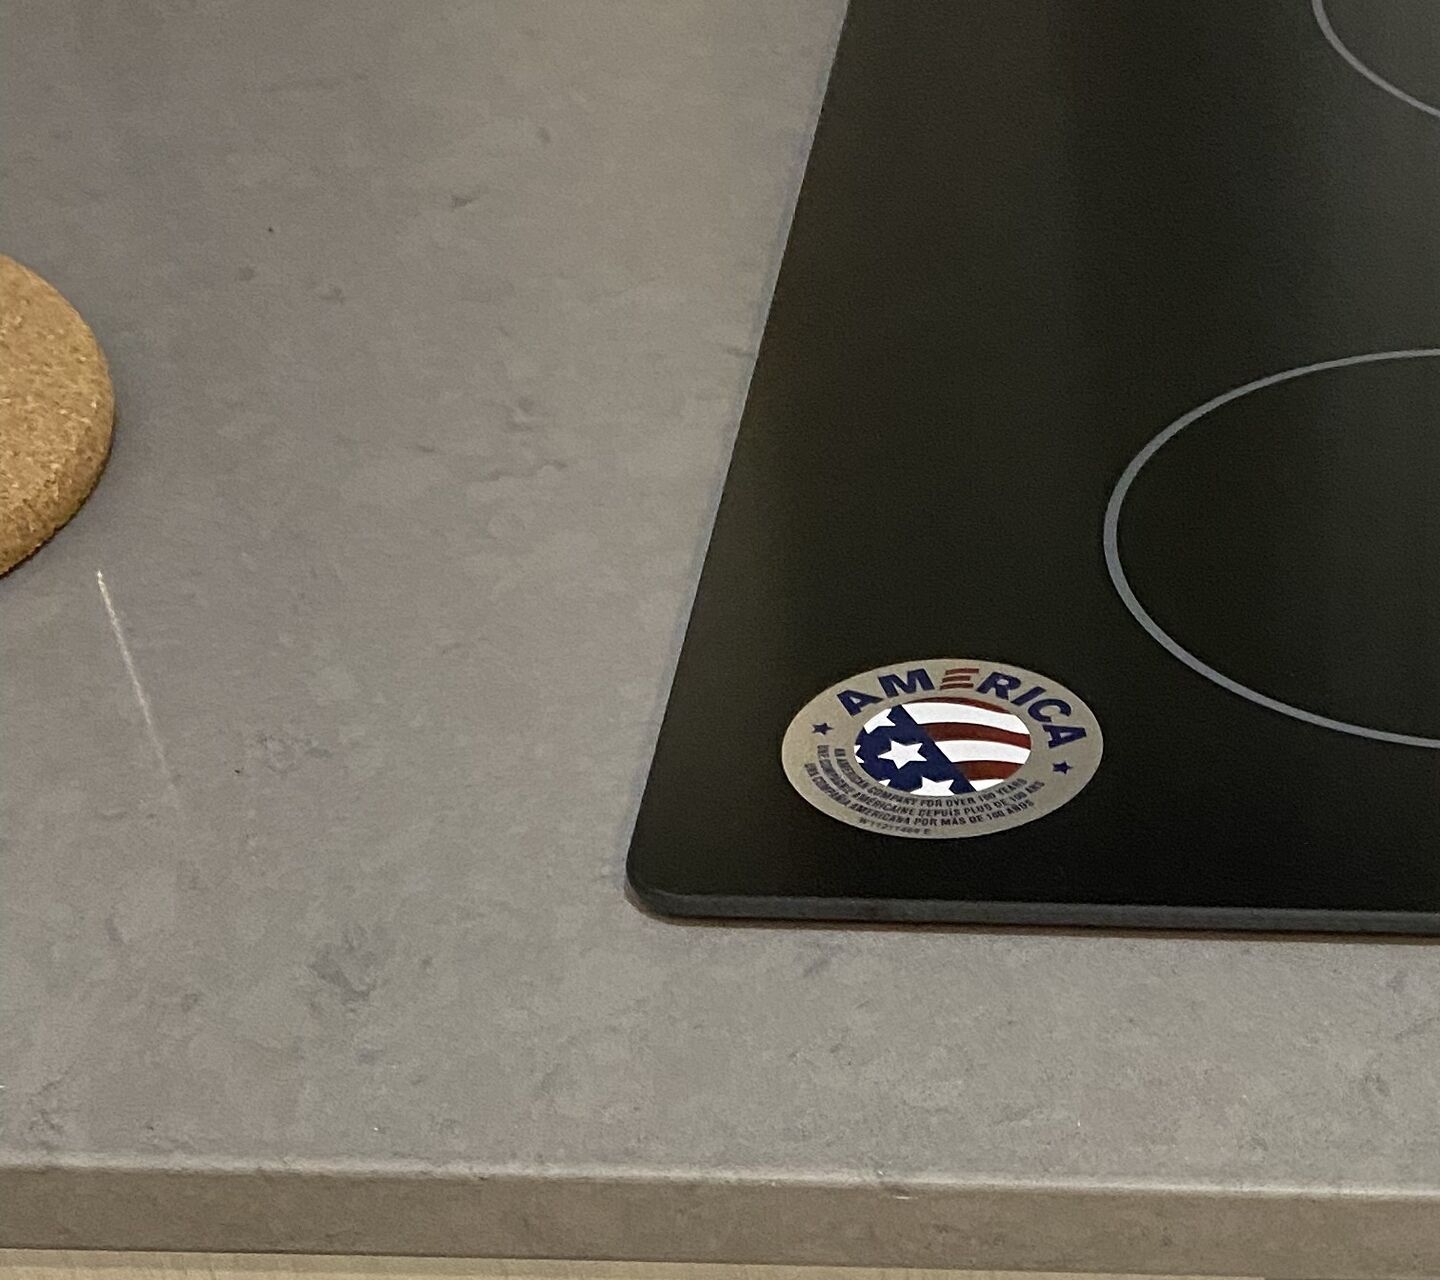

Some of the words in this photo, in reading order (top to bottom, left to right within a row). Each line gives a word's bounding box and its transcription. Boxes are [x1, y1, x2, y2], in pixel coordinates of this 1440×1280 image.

[836, 666, 1088, 749] AMERICA
[866, 786, 919, 806] COMPANY
[920, 798, 943, 808] FOR
[945, 797, 977, 807] OVER
[997, 777, 1029, 796] YEARS
[964, 804, 993, 816] PLUS
[994, 799, 1010, 809] DE
[1026, 780, 1046, 794] ANS
[849, 803, 911, 825] AMERICANA
[913, 817, 939, 827] POR
[968, 814, 985, 824] DE
